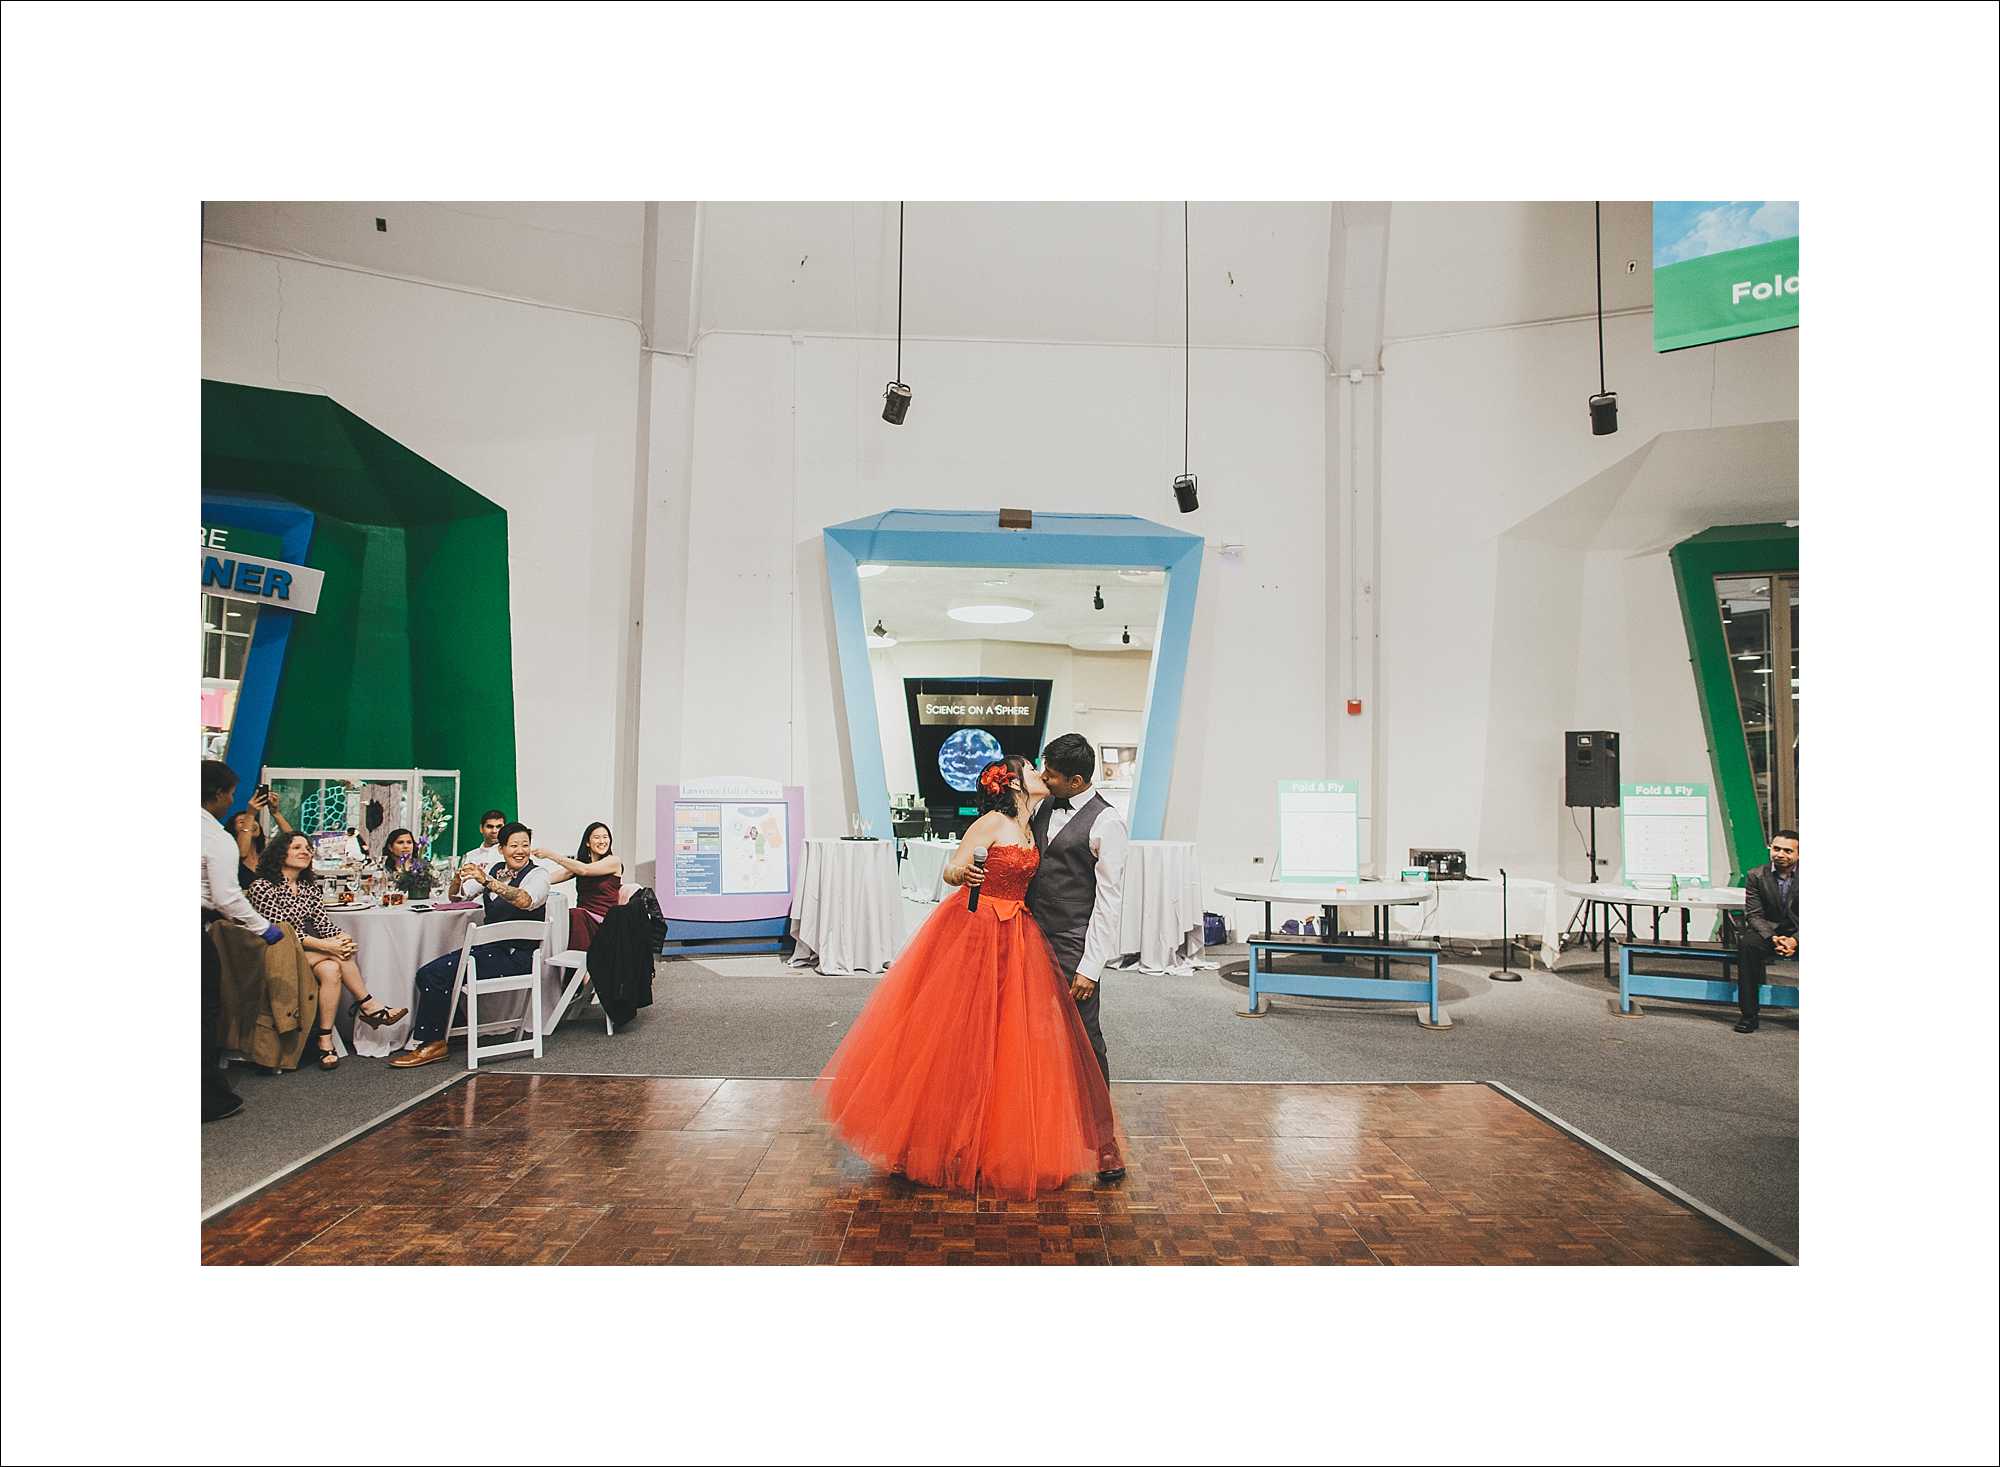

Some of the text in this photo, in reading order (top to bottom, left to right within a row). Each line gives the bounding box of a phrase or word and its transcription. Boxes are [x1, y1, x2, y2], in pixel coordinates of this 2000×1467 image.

[201, 556, 292, 600] NER
[968, 706, 983, 715] ON
[985, 706, 994, 715] A
[1328, 783, 1344, 793] Fly
[1635, 785, 1693, 796] Fold & Fly
